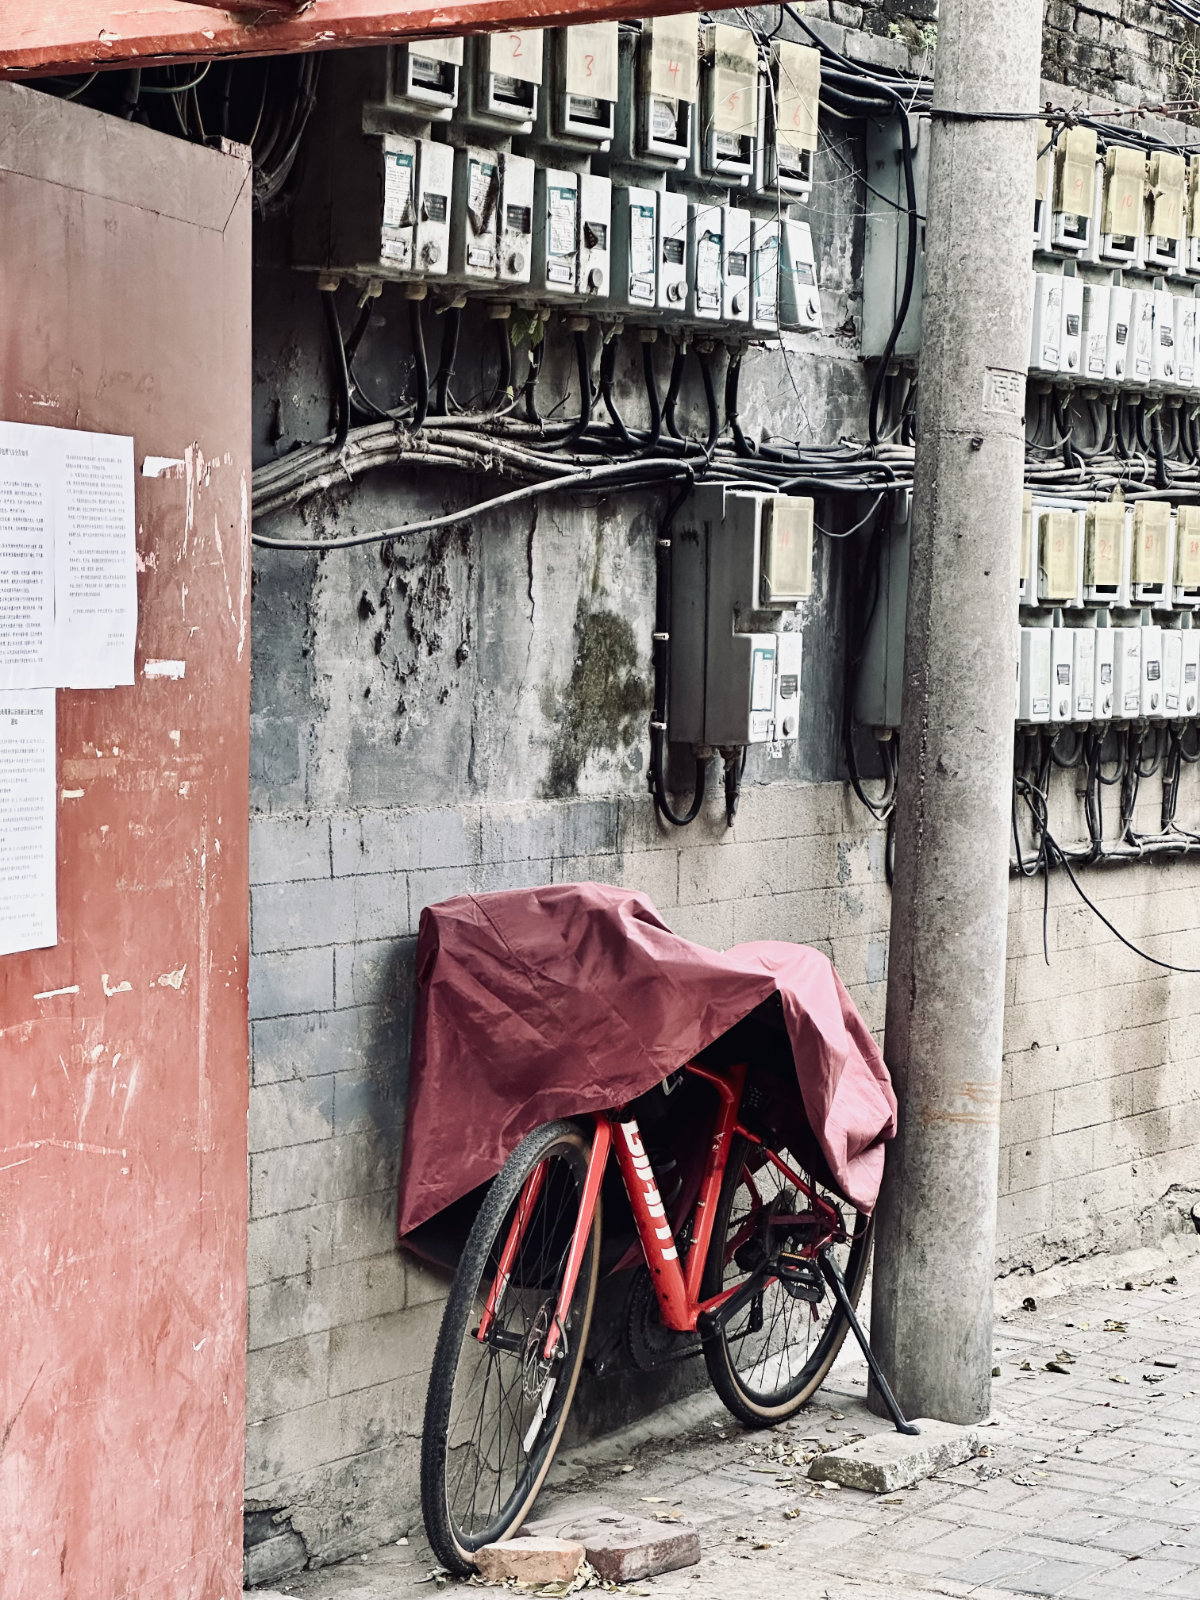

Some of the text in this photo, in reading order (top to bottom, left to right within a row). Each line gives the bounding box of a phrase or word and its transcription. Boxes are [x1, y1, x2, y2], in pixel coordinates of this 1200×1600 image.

[509, 35, 523, 58] 2
[584, 54, 594, 77] 3
[668, 59, 680, 83] 4
[728, 92, 739, 112] 5
[792, 103, 802, 127] 6
